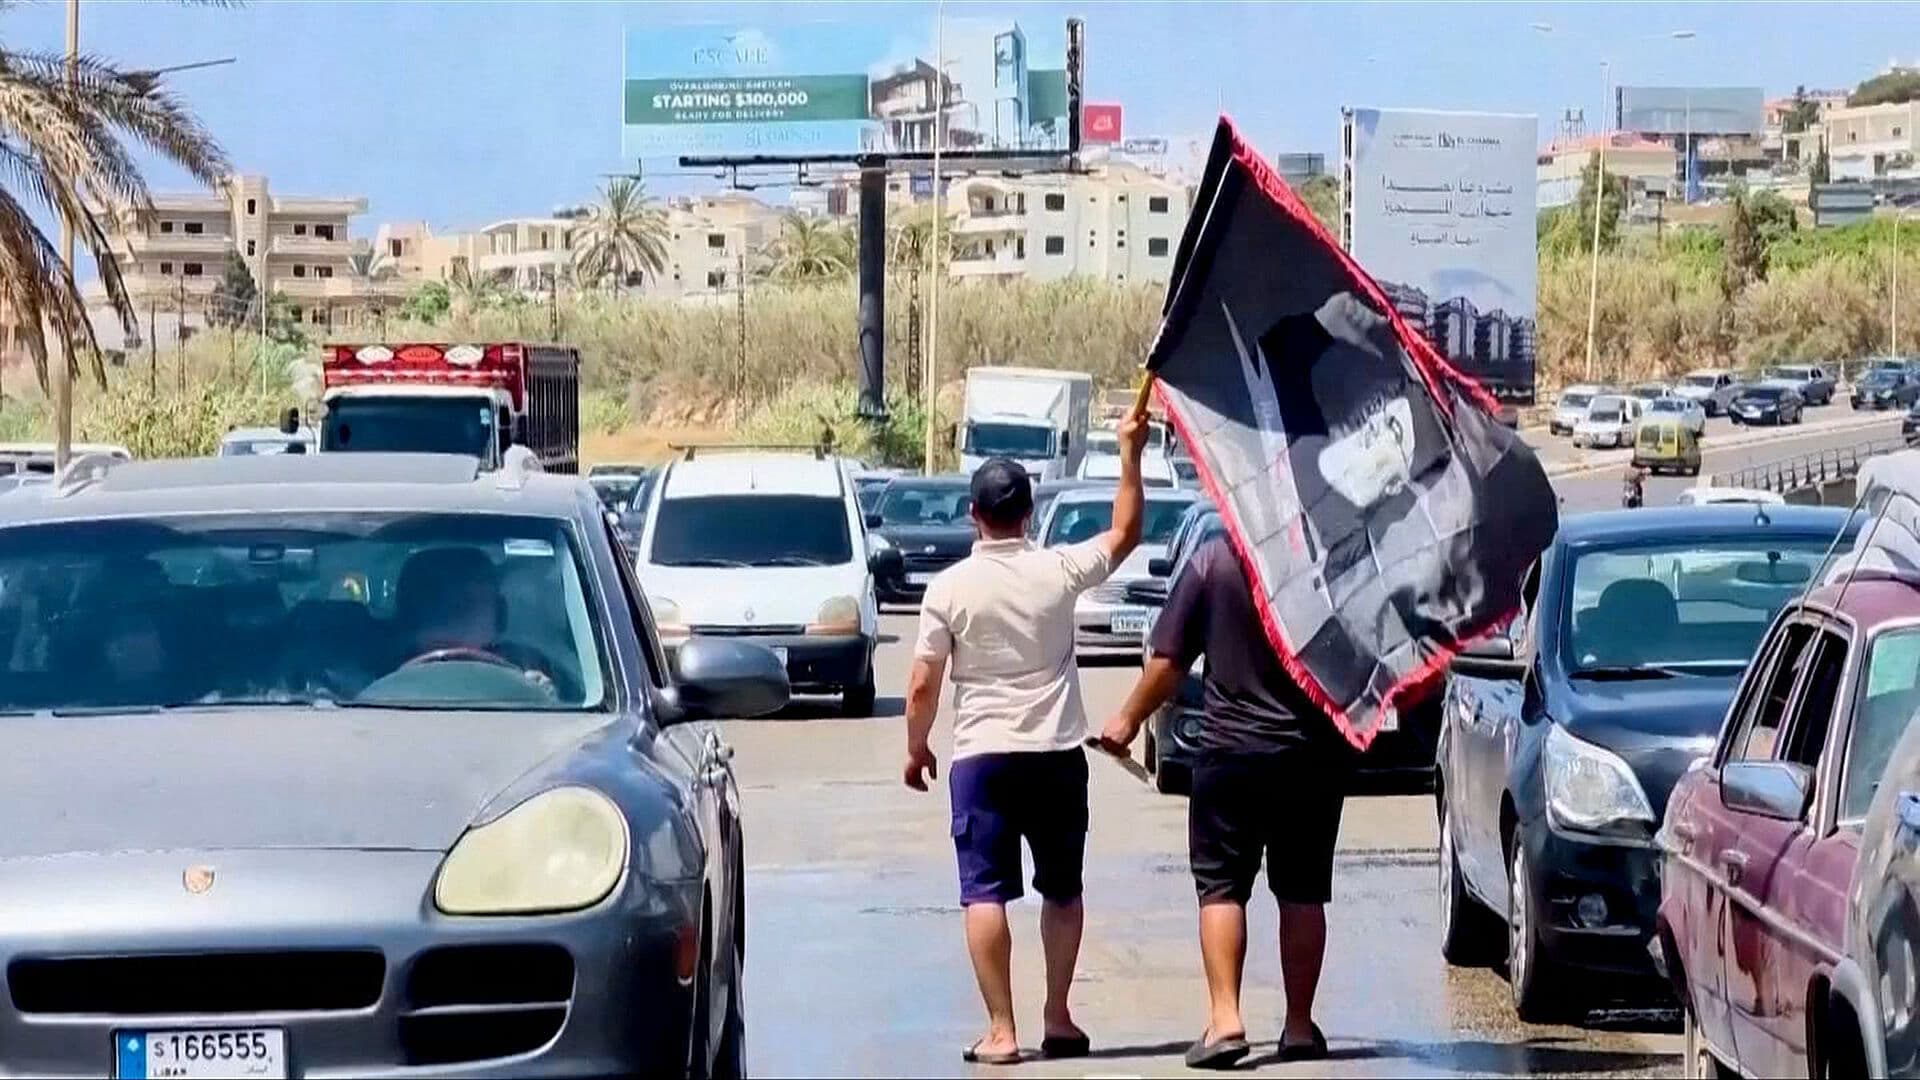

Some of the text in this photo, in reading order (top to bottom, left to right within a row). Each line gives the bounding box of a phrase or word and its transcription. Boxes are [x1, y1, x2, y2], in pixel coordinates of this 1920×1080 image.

[652, 91, 808, 109] STARTING $300,000
[674, 110, 784, 120] READY FOR DELIVERY
[170, 1032, 267, 1060] 166555
